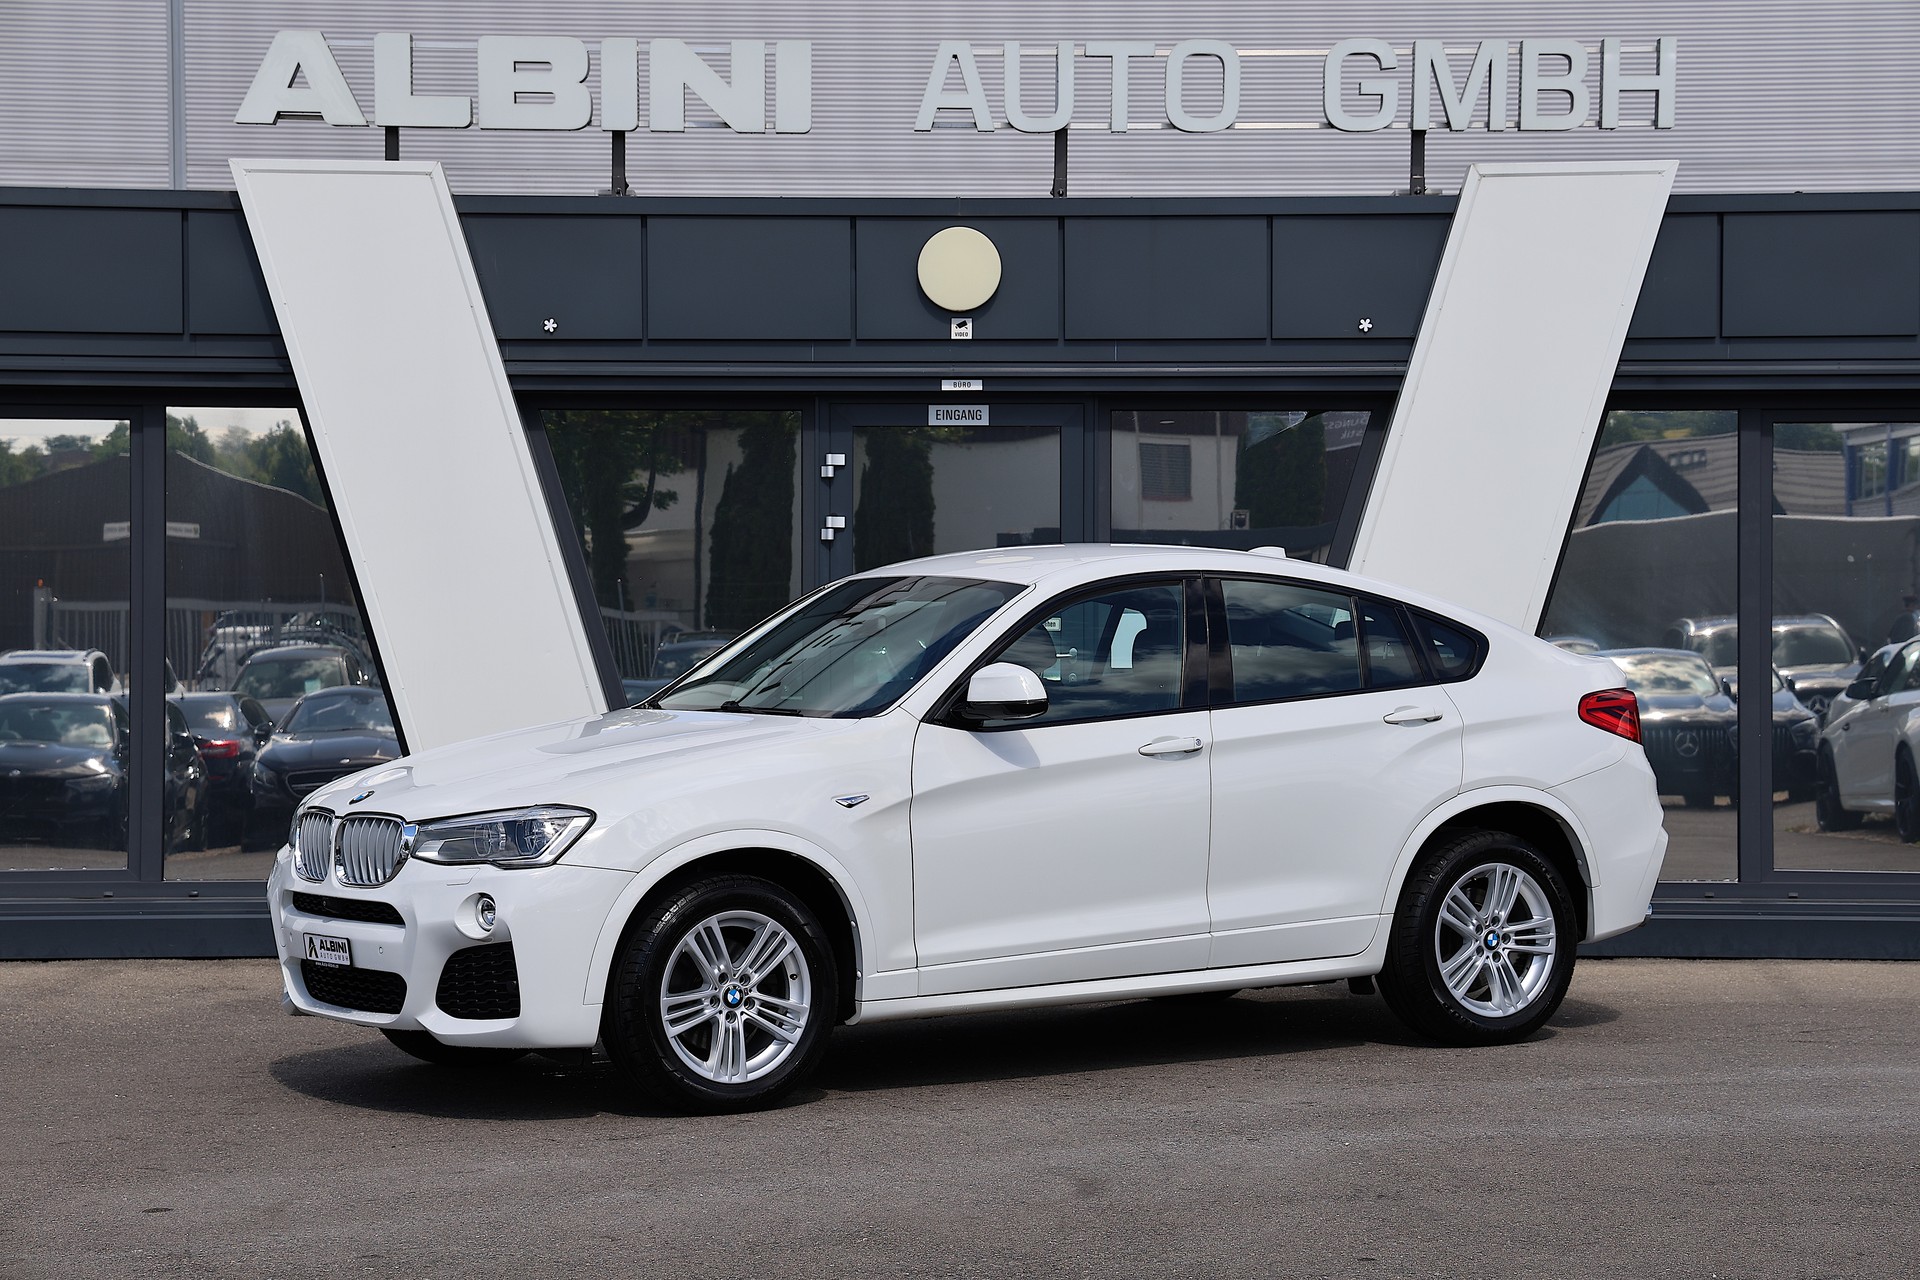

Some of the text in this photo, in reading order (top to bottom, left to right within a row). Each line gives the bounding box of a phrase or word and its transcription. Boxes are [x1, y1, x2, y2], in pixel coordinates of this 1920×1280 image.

[234, 30, 1678, 134] ALBINI AUTO GMBH
[935, 409, 983, 421] EINGANG
[320, 939, 347, 954] ALBINI
